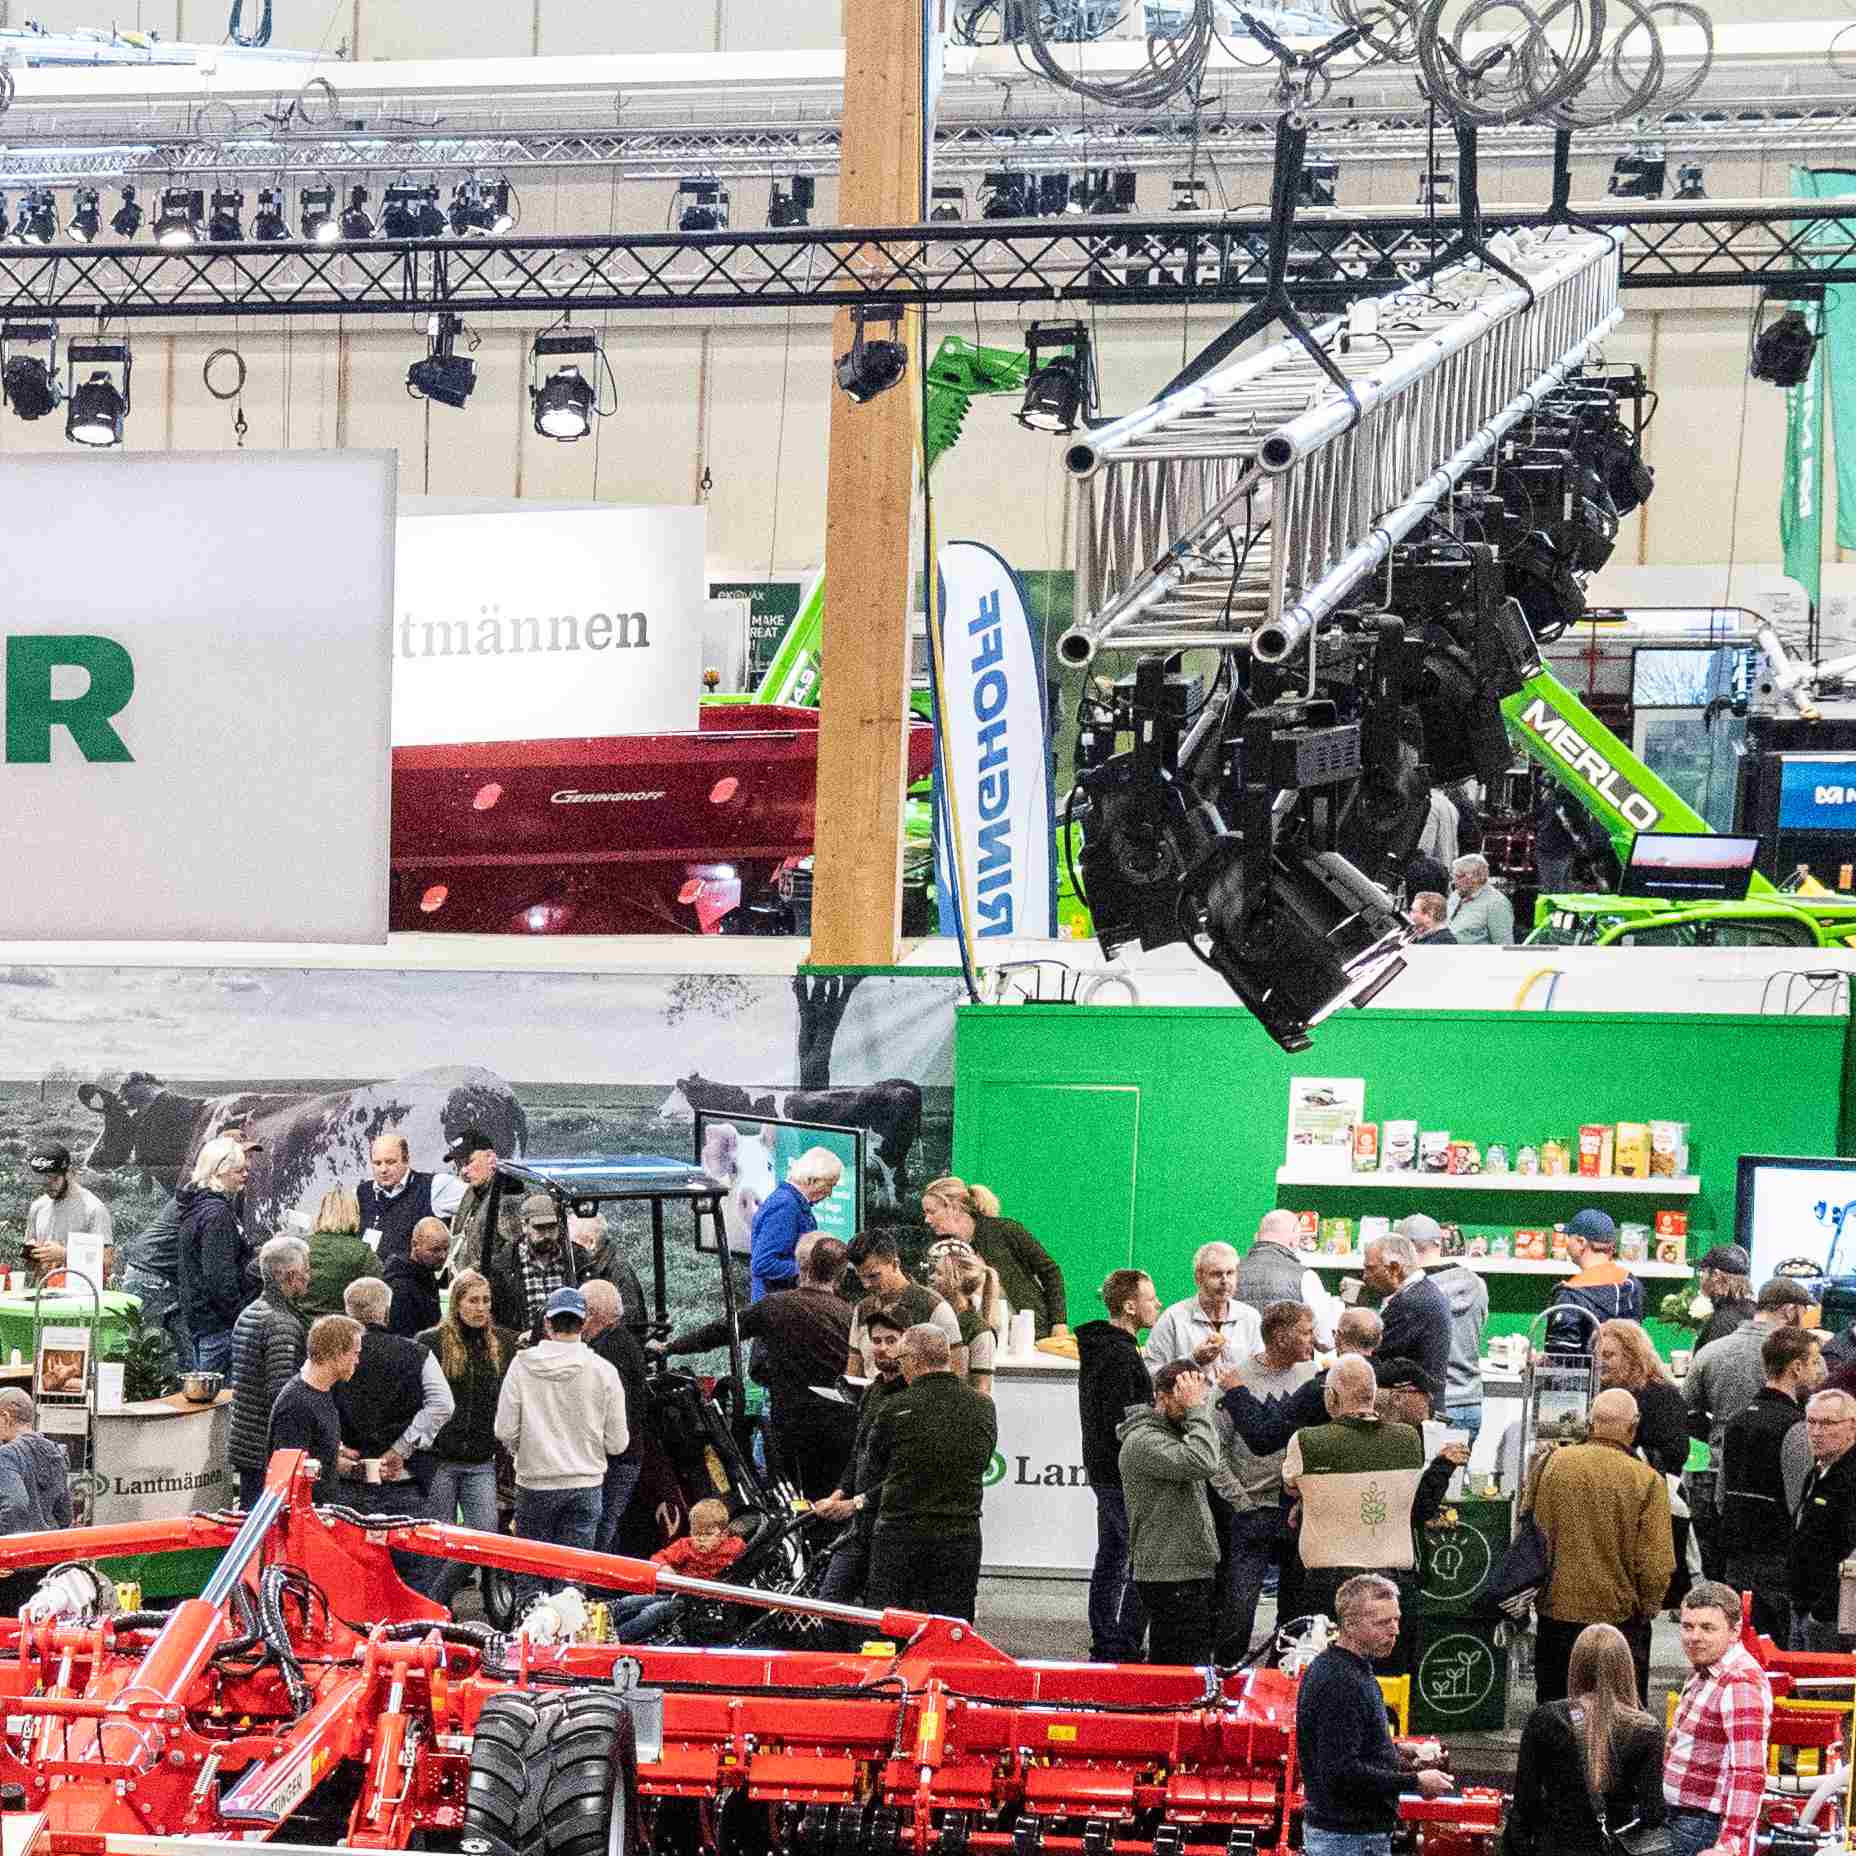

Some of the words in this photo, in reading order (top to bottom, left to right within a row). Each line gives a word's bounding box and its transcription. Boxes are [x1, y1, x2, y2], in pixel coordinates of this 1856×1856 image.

[392, 603, 650, 660] tmännen
[749, 627, 778, 638] REAT
[1520, 699, 1659, 831] MERLO
[113, 1468, 224, 1496] Lantmännen
[1014, 1456, 1091, 1487] Lan
